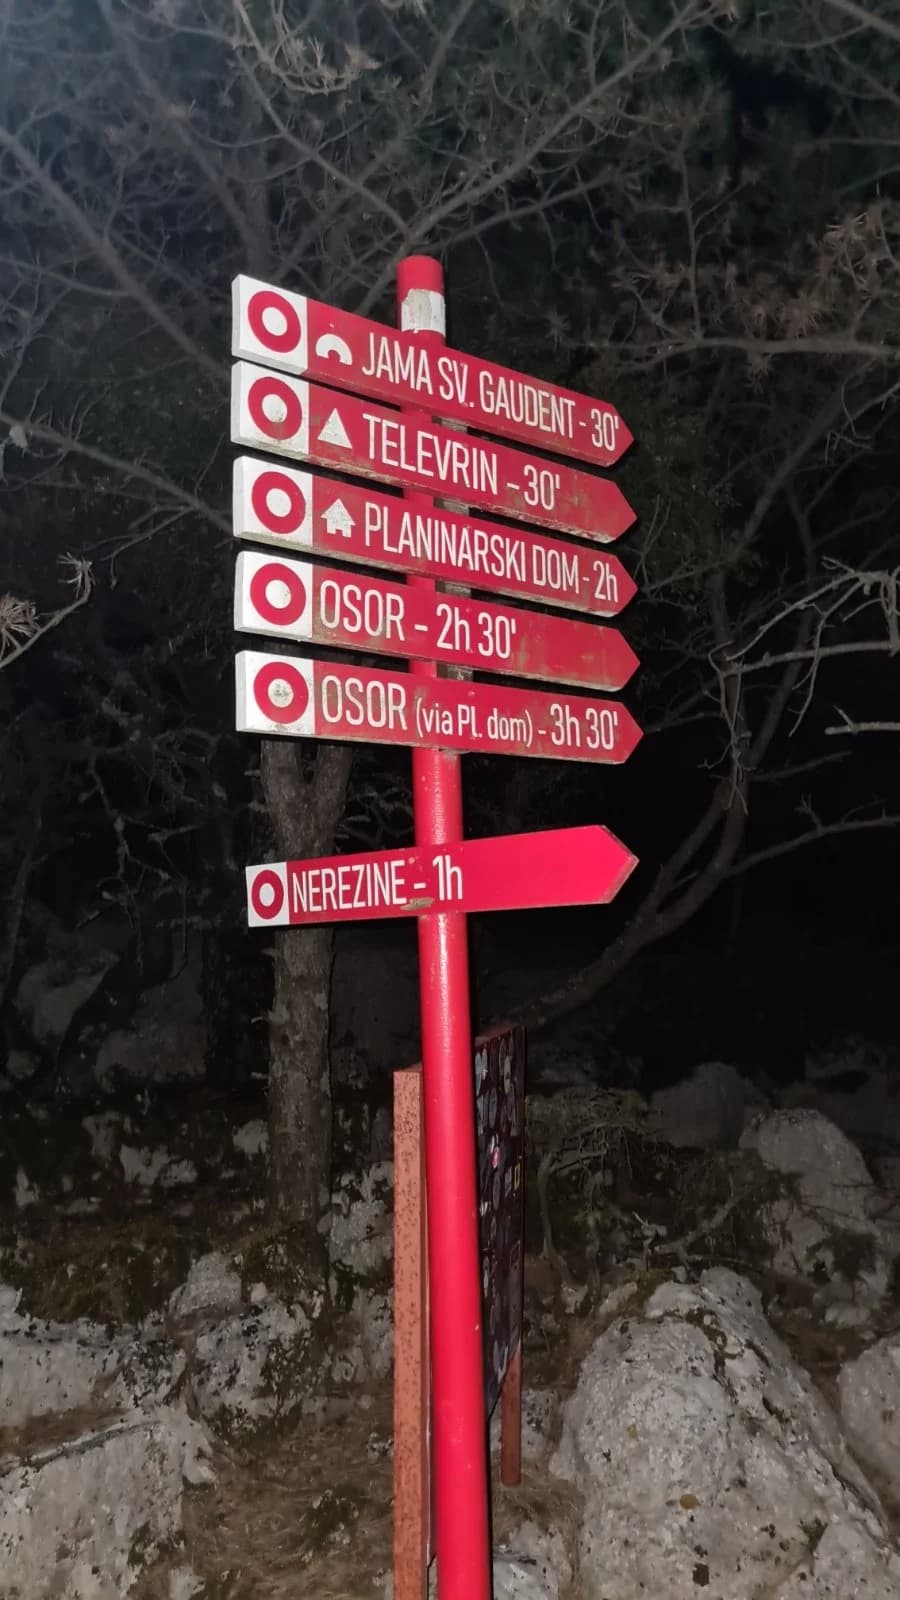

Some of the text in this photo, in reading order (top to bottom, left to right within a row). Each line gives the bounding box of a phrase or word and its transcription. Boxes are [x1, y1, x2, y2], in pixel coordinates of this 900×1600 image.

[362, 332, 433, 395] JAMA
[439, 356, 475, 408] SV.
[479, 370, 575, 439] GAUDENT
[590, 409, 619, 451] 30'
[362, 413, 498, 495] TELEVRIN
[523, 464, 561, 510] 30'
[364, 502, 526, 583] PLANINARSKI
[533, 544, 580, 595] DOM
[592, 560, 619, 603] 2h
[319, 580, 406, 642] OSOR
[436, 603, 471, 652] 2h
[478, 612, 517, 659] 30'
[321, 675, 408, 731] OSOR
[415, 696, 453, 738] (via
[458, 704, 482, 739] Pl.
[487, 709, 533, 748] dom)
[550, 703, 581, 749] 3h
[586, 708, 618, 750] 30'
[292, 859, 407, 914] NEREZINE
[432, 854, 463, 902] 1h
